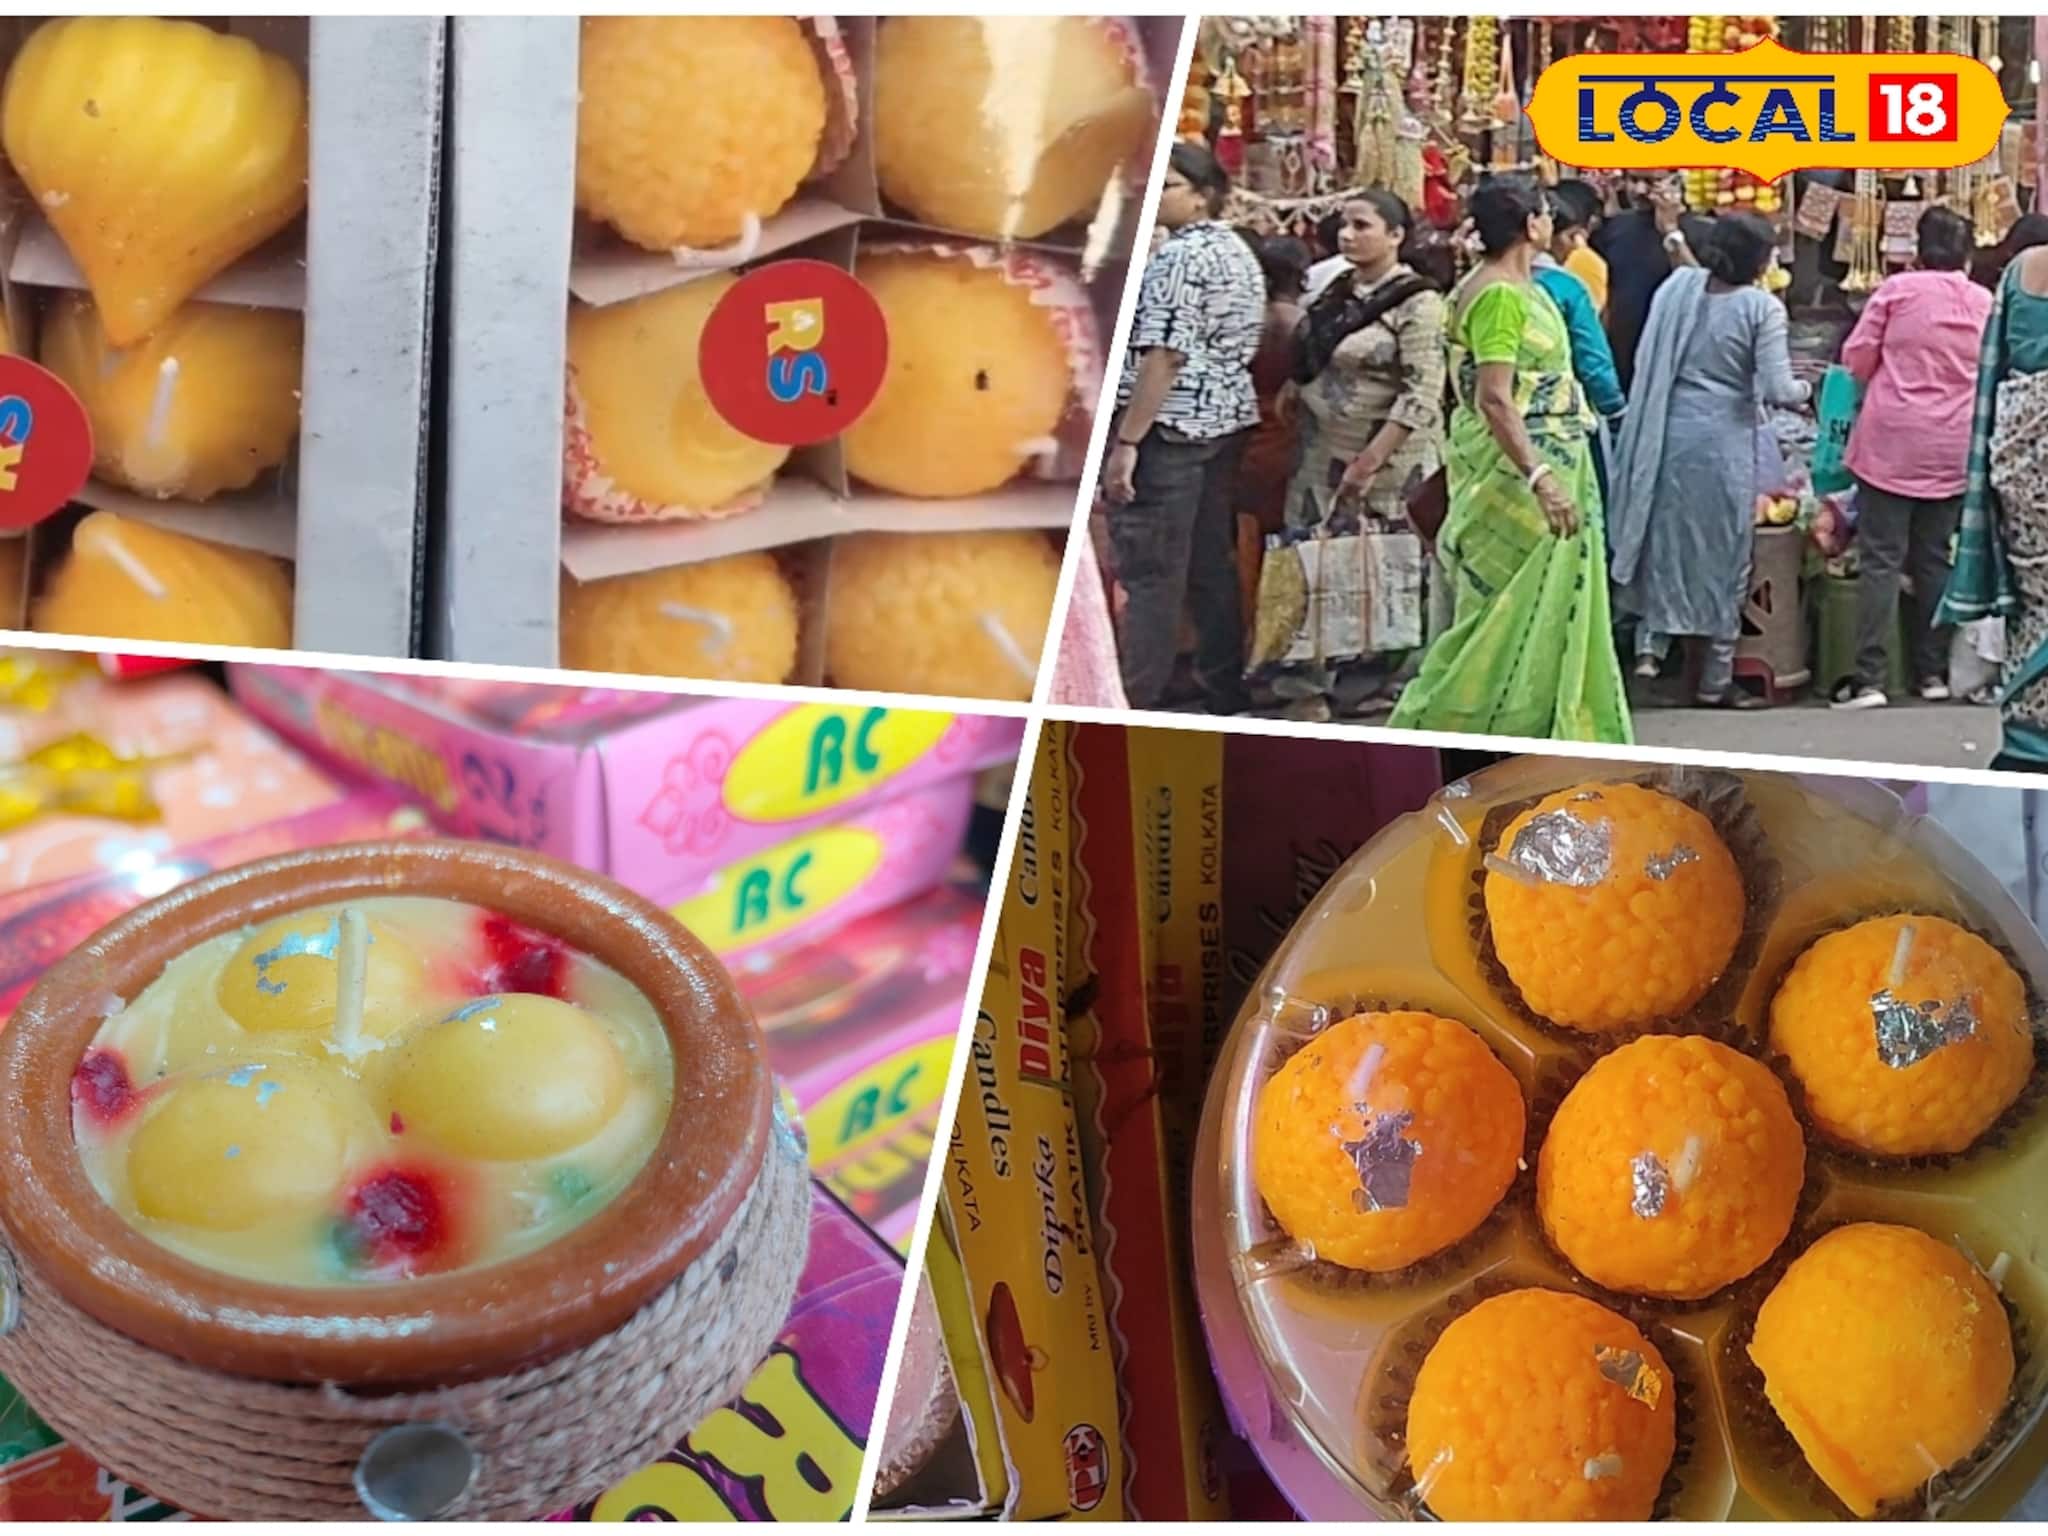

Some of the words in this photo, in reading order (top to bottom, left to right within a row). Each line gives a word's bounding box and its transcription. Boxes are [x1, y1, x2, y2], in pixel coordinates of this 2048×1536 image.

[764, 297, 828, 402] RS
[732, 851, 812, 931] RC
[1201, 784, 1217, 886] KOLKATA
[1017, 947, 1052, 1078] Diya
[972, 1010, 1011, 1179] Candles
[1033, 1136, 1075, 1294] Dipika
[1066, 1120, 1088, 1255] PRATIK
